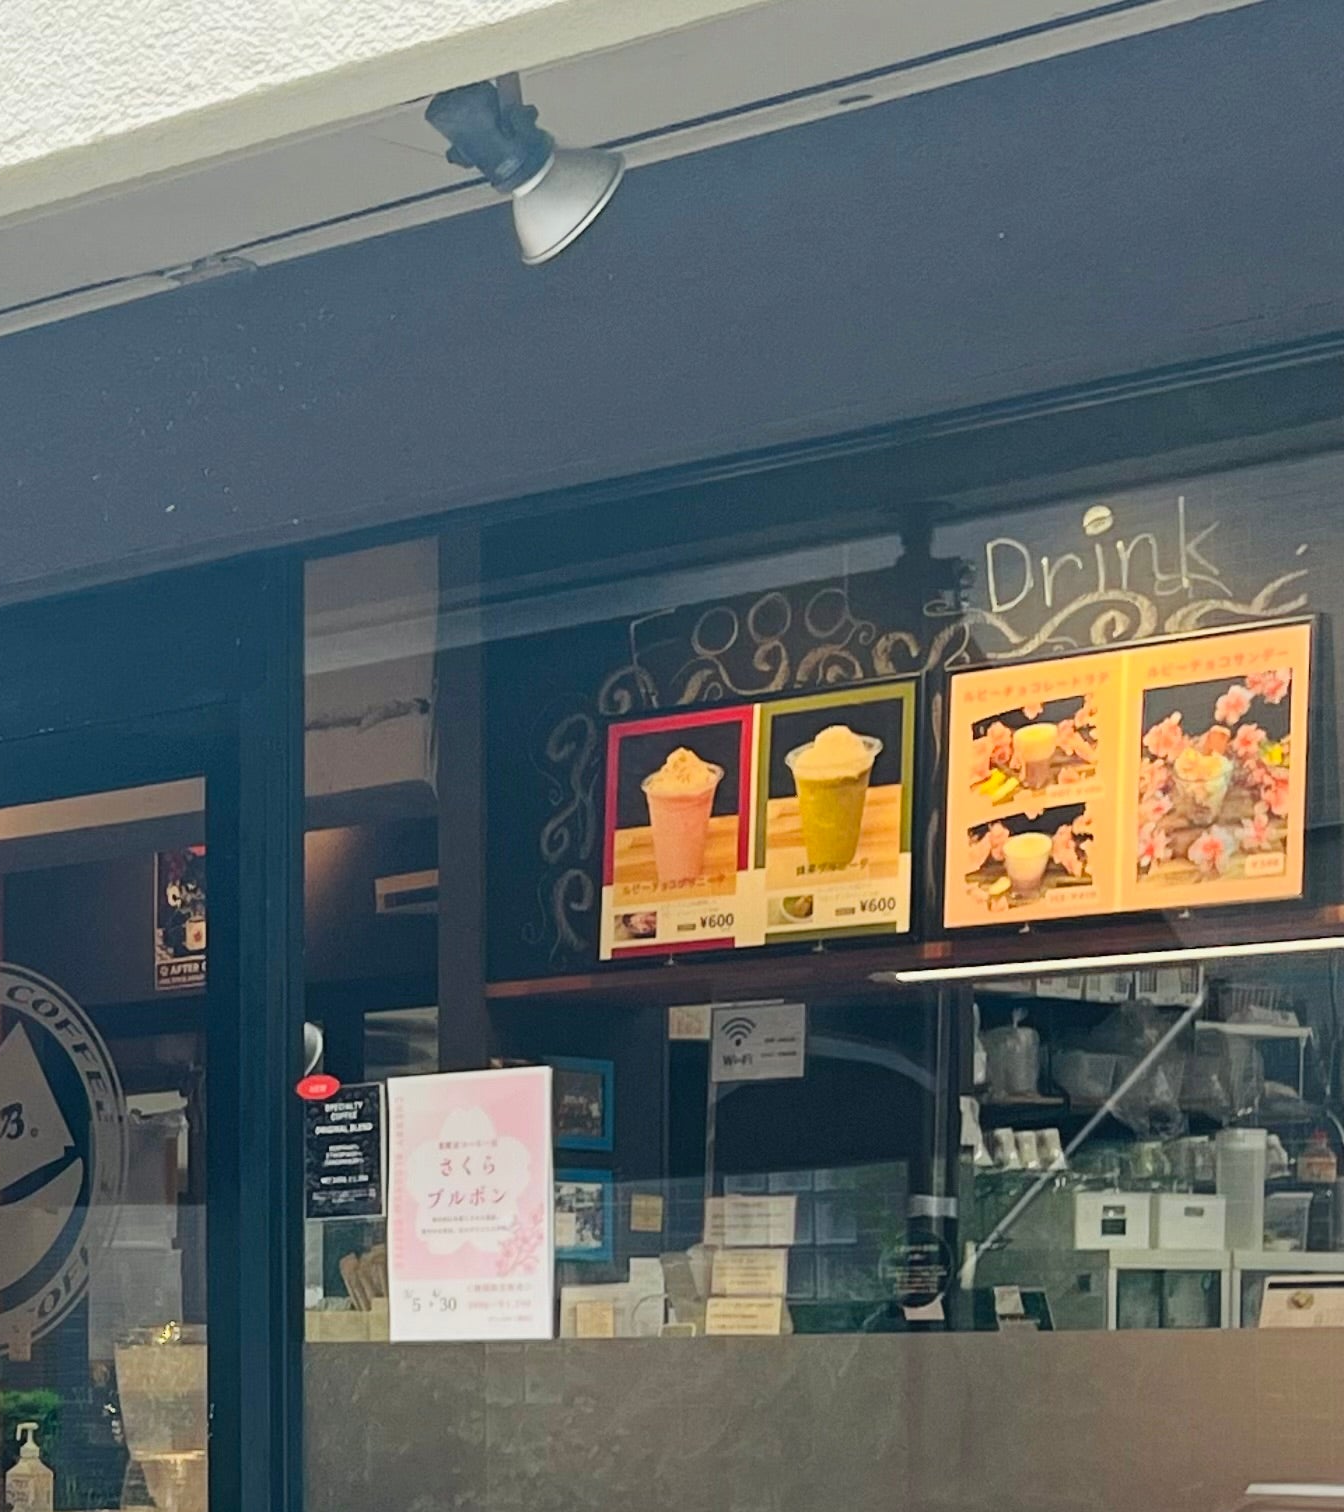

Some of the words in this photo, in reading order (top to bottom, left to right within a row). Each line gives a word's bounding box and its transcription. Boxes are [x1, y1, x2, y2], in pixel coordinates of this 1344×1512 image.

[986, 496, 1232, 612] Drink
[859, 897, 896, 913] ¥600
[699, 913, 734, 929] ¥600
[440, 1156, 495, 1176] さくら
[427, 1186, 507, 1208] ブルボン
